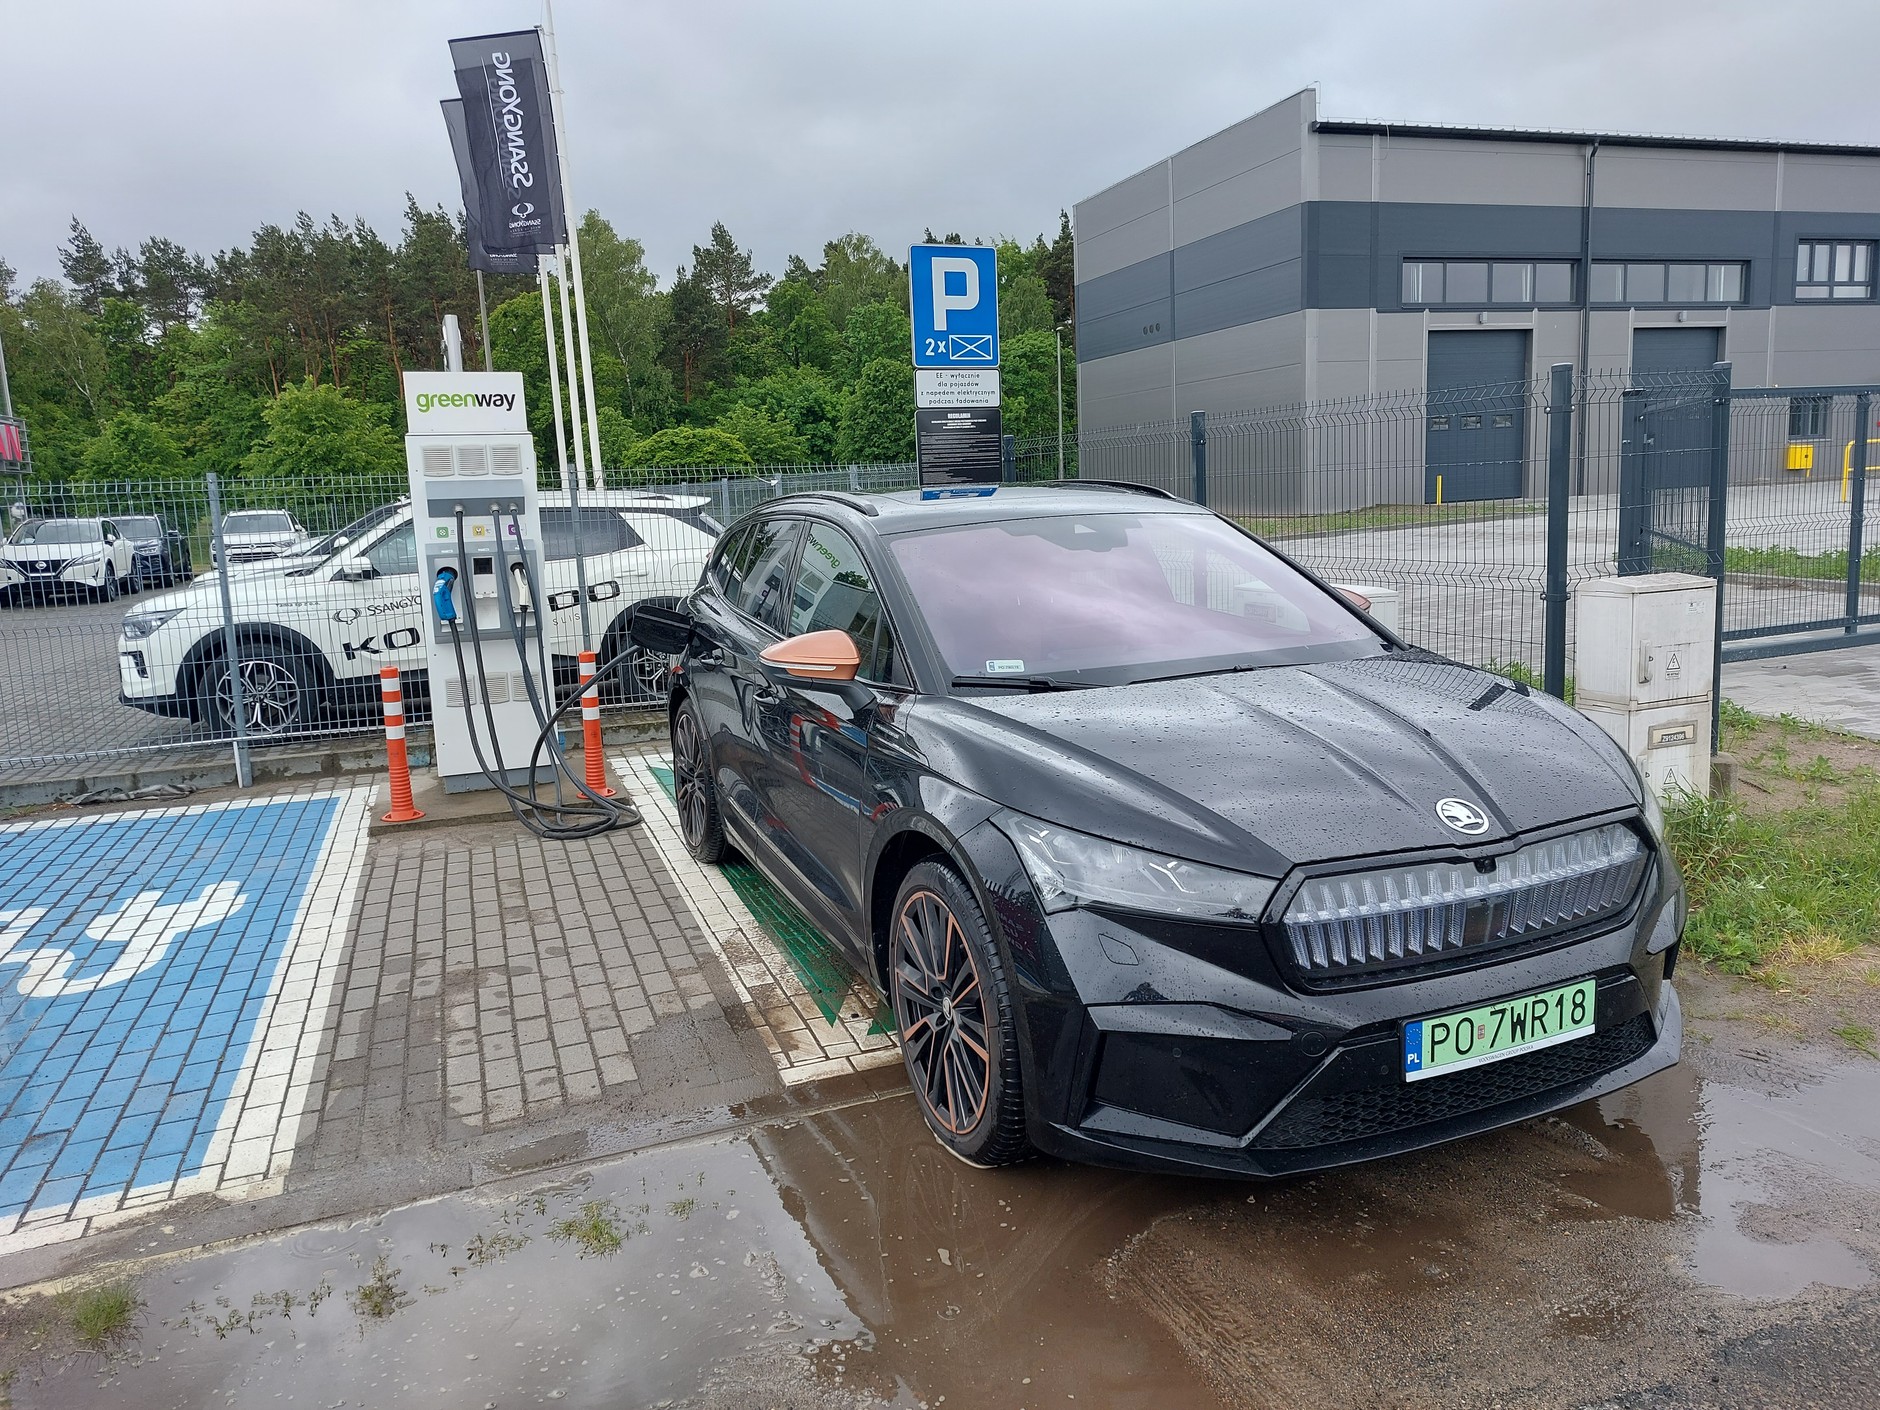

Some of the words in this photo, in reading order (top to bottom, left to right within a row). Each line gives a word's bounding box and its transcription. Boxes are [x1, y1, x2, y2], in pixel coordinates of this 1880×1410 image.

[931, 256, 980, 331] P
[925, 338, 935, 356] 2
[929, 398, 954, 406] podczas
[957, 389, 996, 397] elektrycznym
[416, 393, 516, 413] greenway
[1430, 1017, 1475, 1063] PO
[1489, 988, 1587, 1050] 7WR18
[1407, 1053, 1420, 1065] PL
